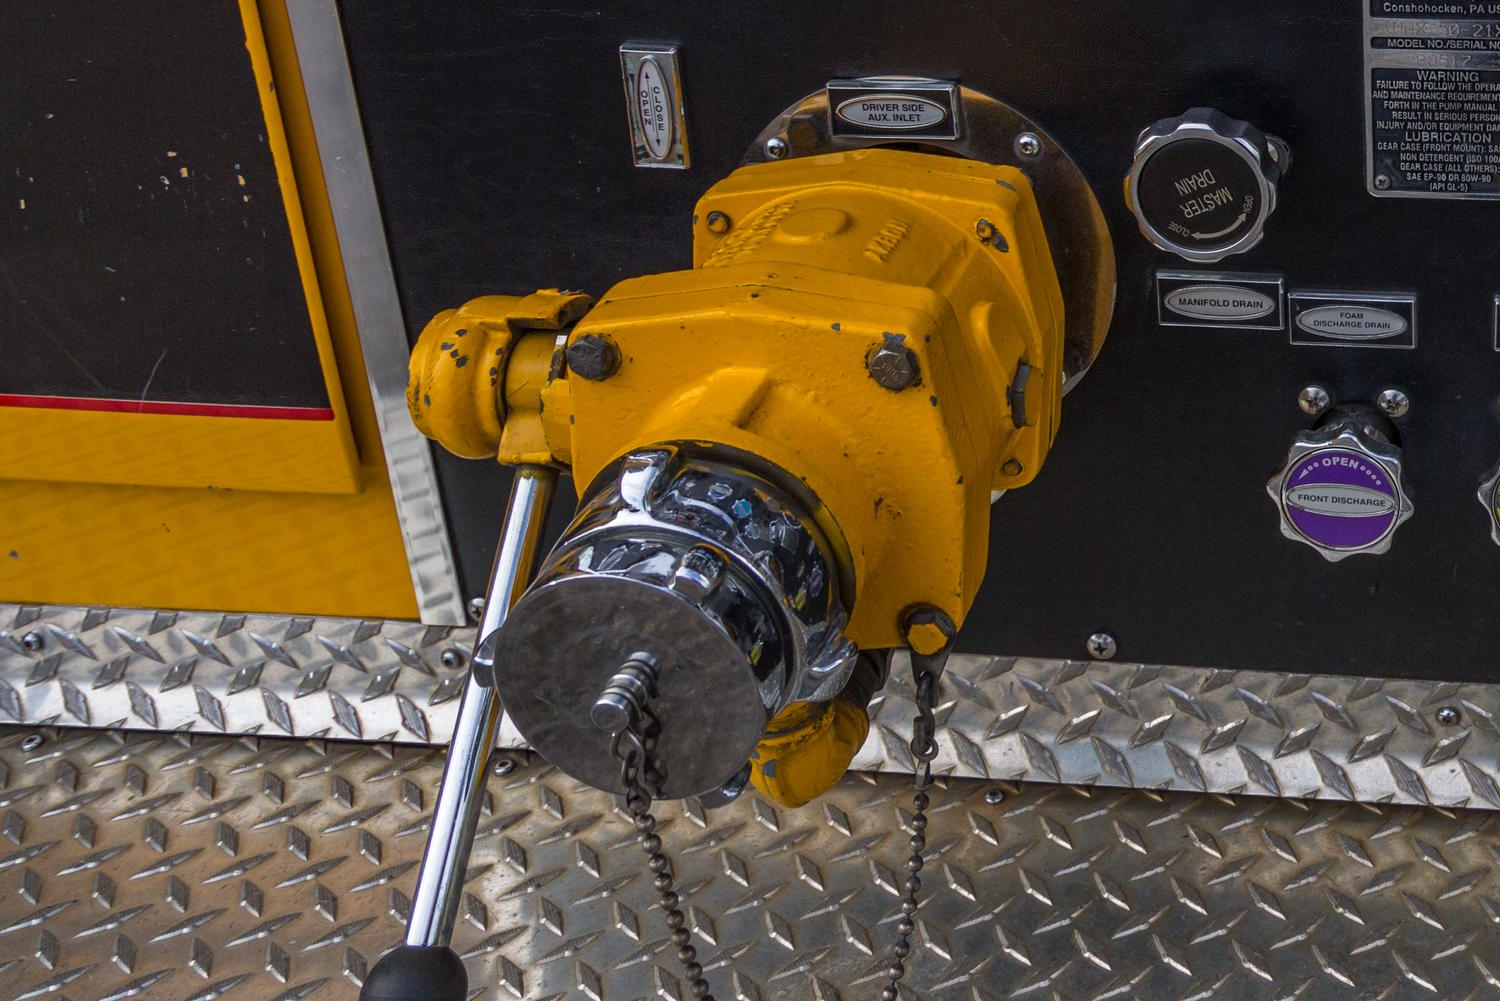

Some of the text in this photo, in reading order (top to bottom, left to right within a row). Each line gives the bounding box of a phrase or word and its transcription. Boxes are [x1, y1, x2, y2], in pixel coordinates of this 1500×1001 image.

[1384, 3, 1466, 15] Conshohocken,
[1470, 5, 1485, 13] PA
[1388, 39, 1425, 48] MODEL
[1428, 40, 1487, 49] NO./SERIAL
[1417, 71, 1479, 82] WARNING
[640, 91, 652, 125] OPEN
[653, 86, 664, 131] CLOSE
[862, 104, 924, 112] DRIVER SIDE
[893, 114, 920, 122] INLET
[1406, 132, 1491, 143] LUBRICATION
[1174, 169, 1216, 197] DRAIN
[1180, 187, 1233, 218] MASTER
[1243, 195, 1254, 213] OPEN
[1168, 221, 1190, 237] CLOSE
[1179, 299, 1263, 308] MANIFOLD DRAIN
[1314, 320, 1362, 328] DISCHARGE
[1322, 457, 1358, 469] OPEN
[1298, 494, 1385, 507] FRONT DISCHARGE
